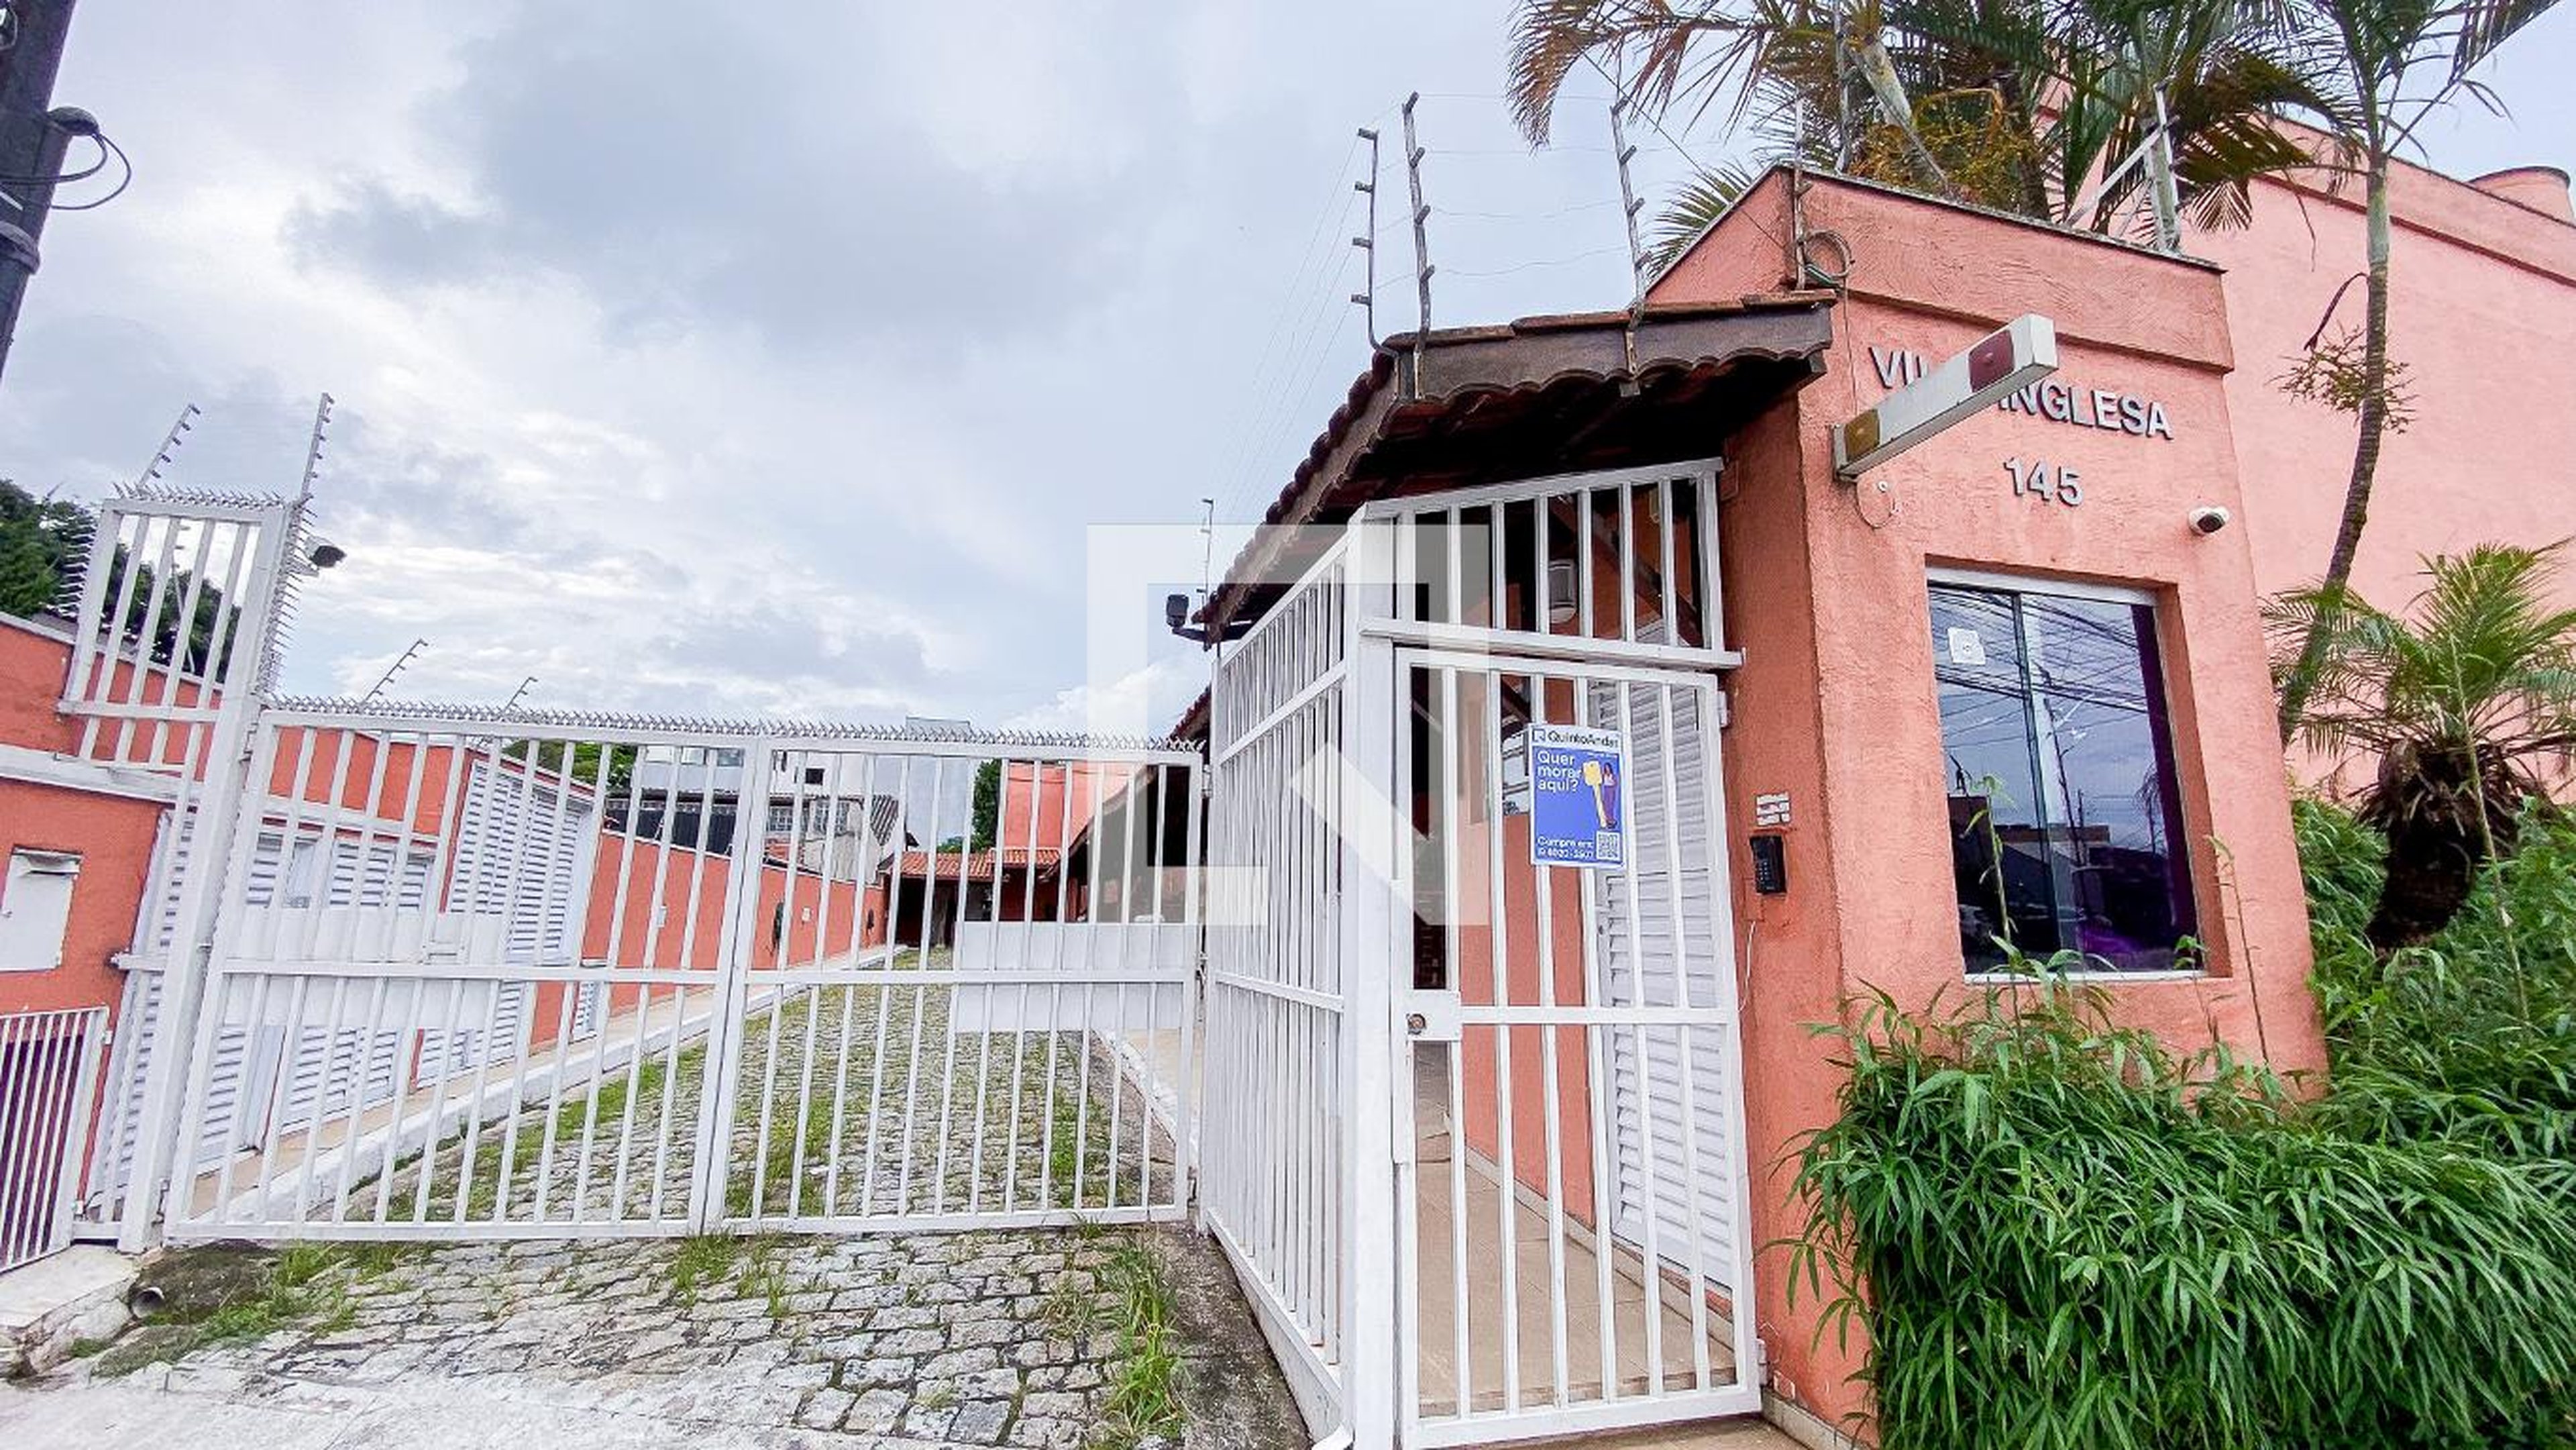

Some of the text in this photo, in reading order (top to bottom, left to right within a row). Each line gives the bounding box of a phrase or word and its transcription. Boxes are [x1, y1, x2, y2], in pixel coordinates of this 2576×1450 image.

[2003, 456, 2084, 507] 145
[1538, 750, 1575, 766] Quer
[1538, 766, 1582, 778] morar
[1538, 778, 1578, 793] aqui?
